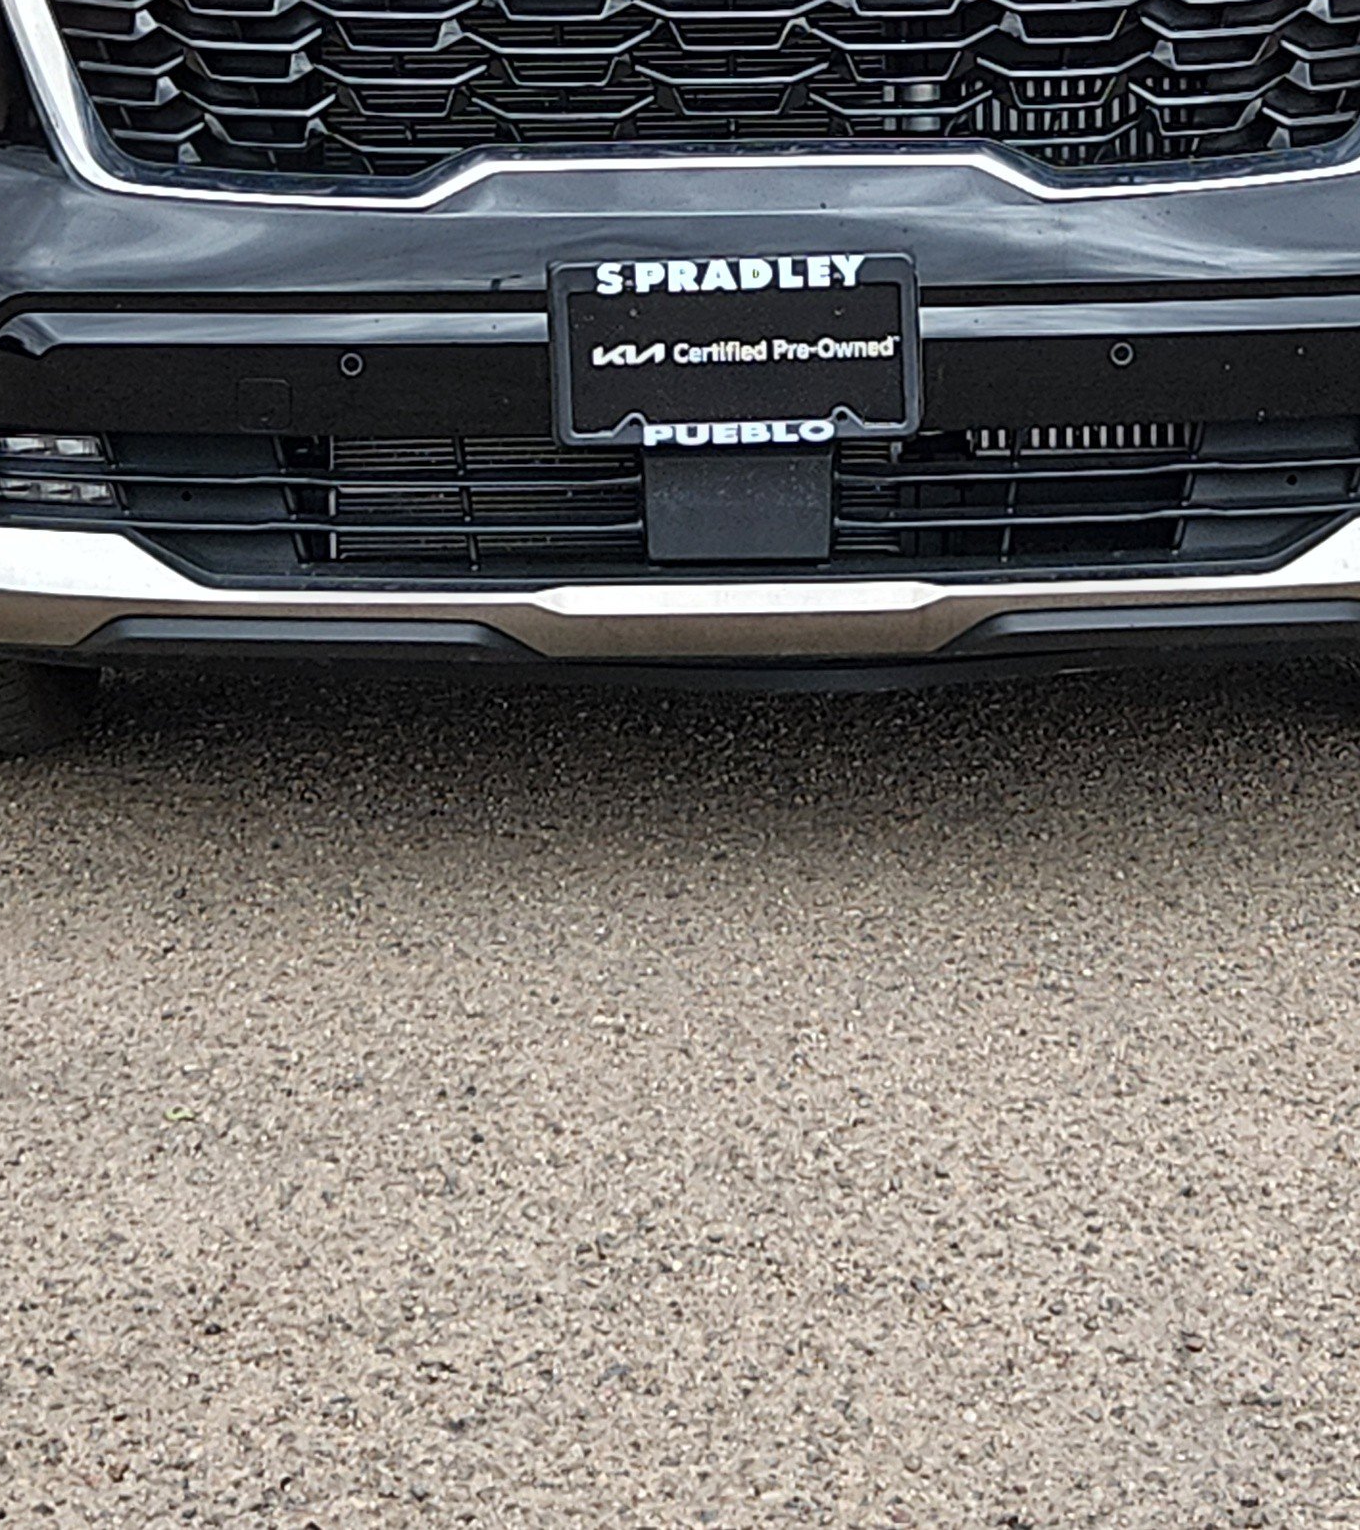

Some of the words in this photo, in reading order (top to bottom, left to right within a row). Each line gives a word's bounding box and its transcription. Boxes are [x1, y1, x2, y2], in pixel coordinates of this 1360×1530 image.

[596, 255, 867, 295] SPRADLEY
[673, 340, 768, 363] Certified
[643, 420, 835, 446] PUEBLO
